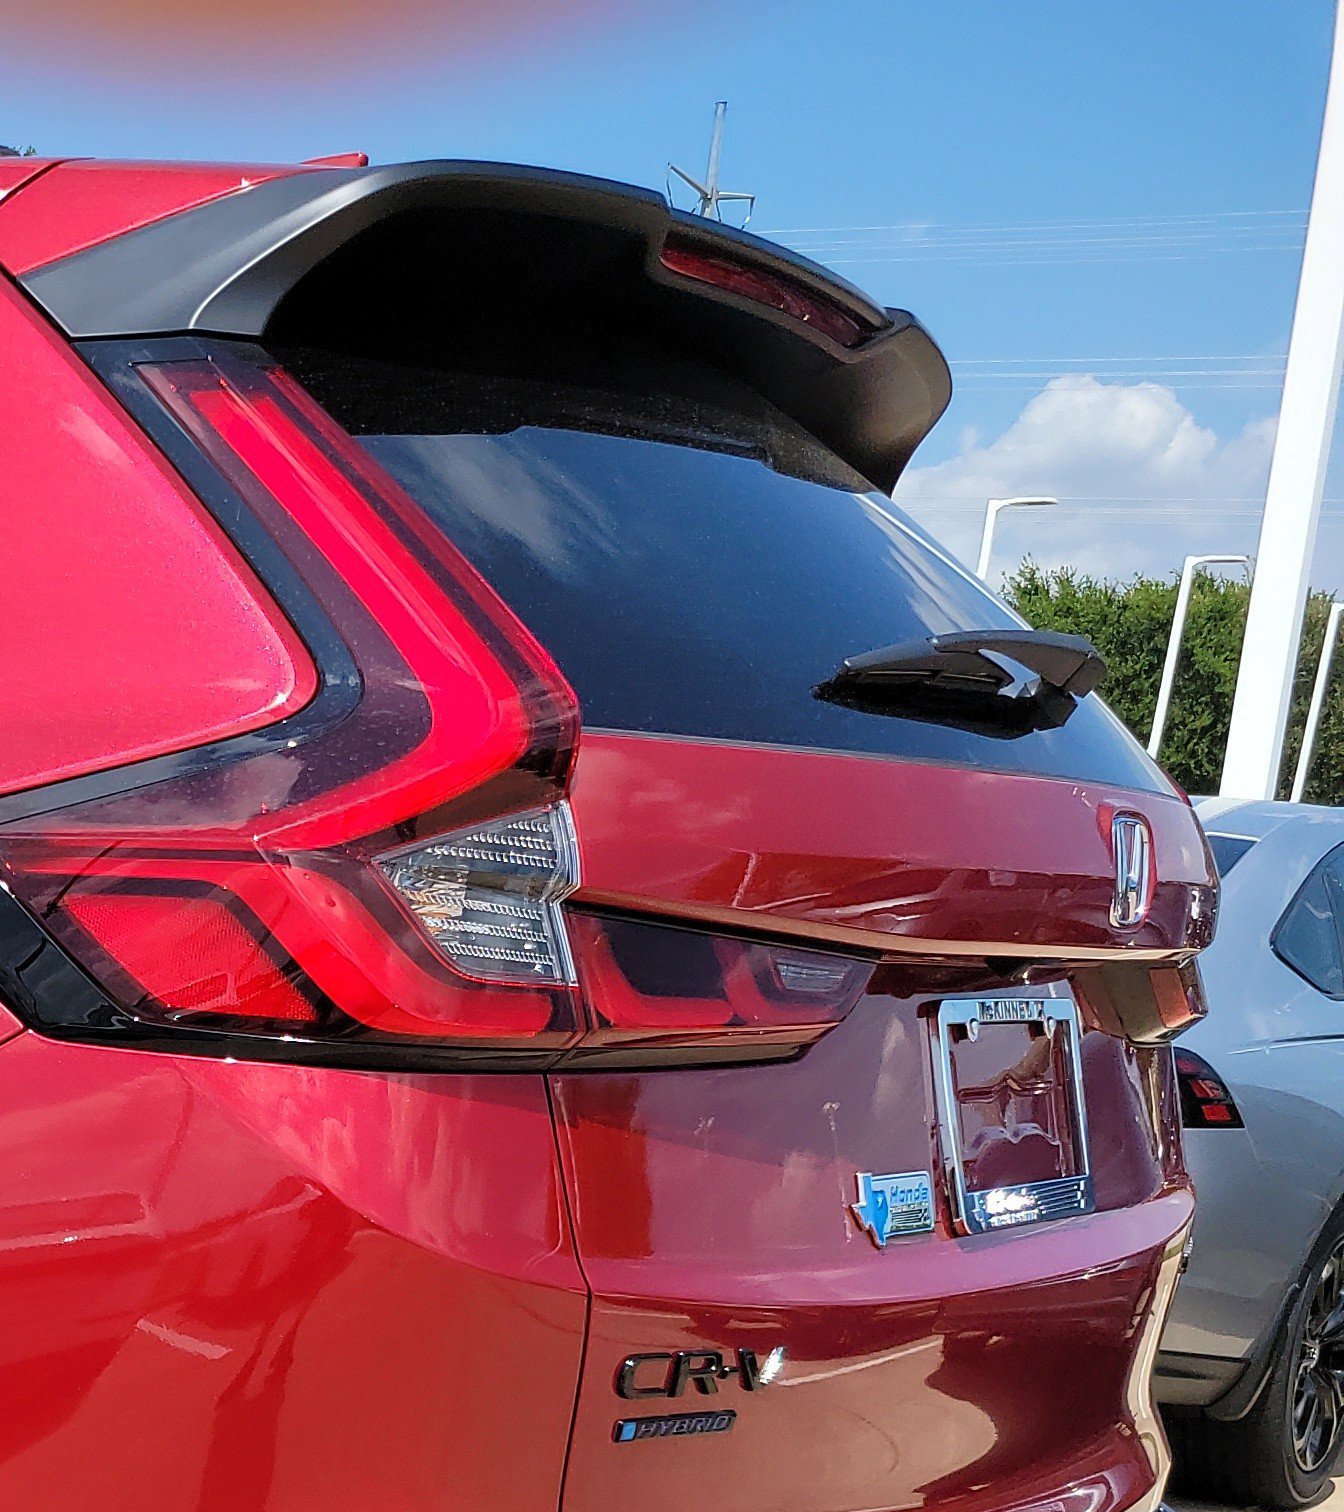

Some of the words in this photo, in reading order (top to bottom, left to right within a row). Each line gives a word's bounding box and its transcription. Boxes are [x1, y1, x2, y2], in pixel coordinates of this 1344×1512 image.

[890, 1183, 928, 1203] Honda
[613, 1347, 787, 1400] CR-V
[636, 1415, 732, 1439] HYBRID
